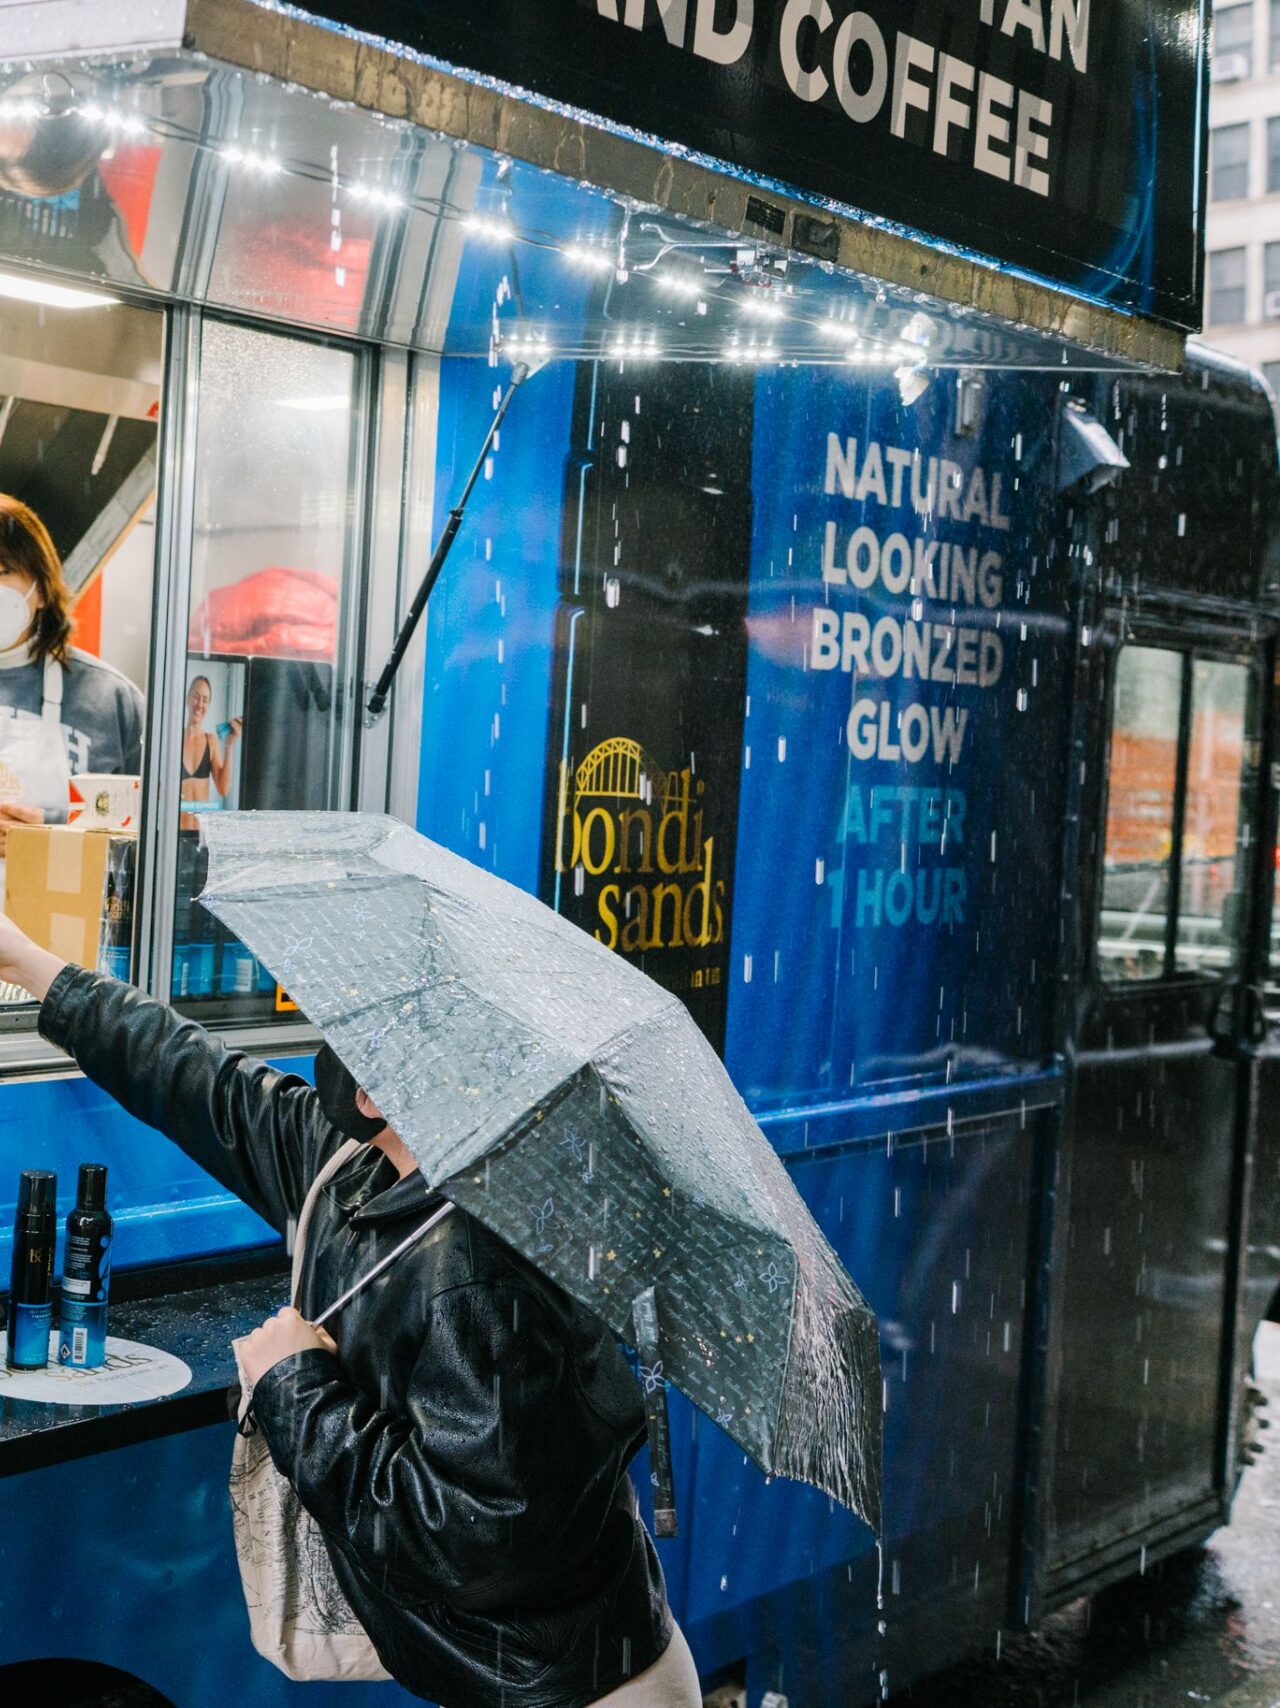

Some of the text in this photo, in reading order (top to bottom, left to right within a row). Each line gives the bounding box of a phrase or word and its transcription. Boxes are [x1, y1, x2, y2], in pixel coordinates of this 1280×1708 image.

[980, 0, 1090, 73] AN
[780, 0, 1053, 197] COFFEE
[824, 432, 1009, 530] NATURAL
[823, 521, 1003, 607] LOOKING
[810, 608, 1004, 688] BRONZED
[847, 699, 968, 764] GLOW
[555, 760, 705, 876] bondi
[835, 785, 967, 843] AFTER
[595, 836, 725, 951] sands
[827, 867, 967, 929] 1 HOUR
